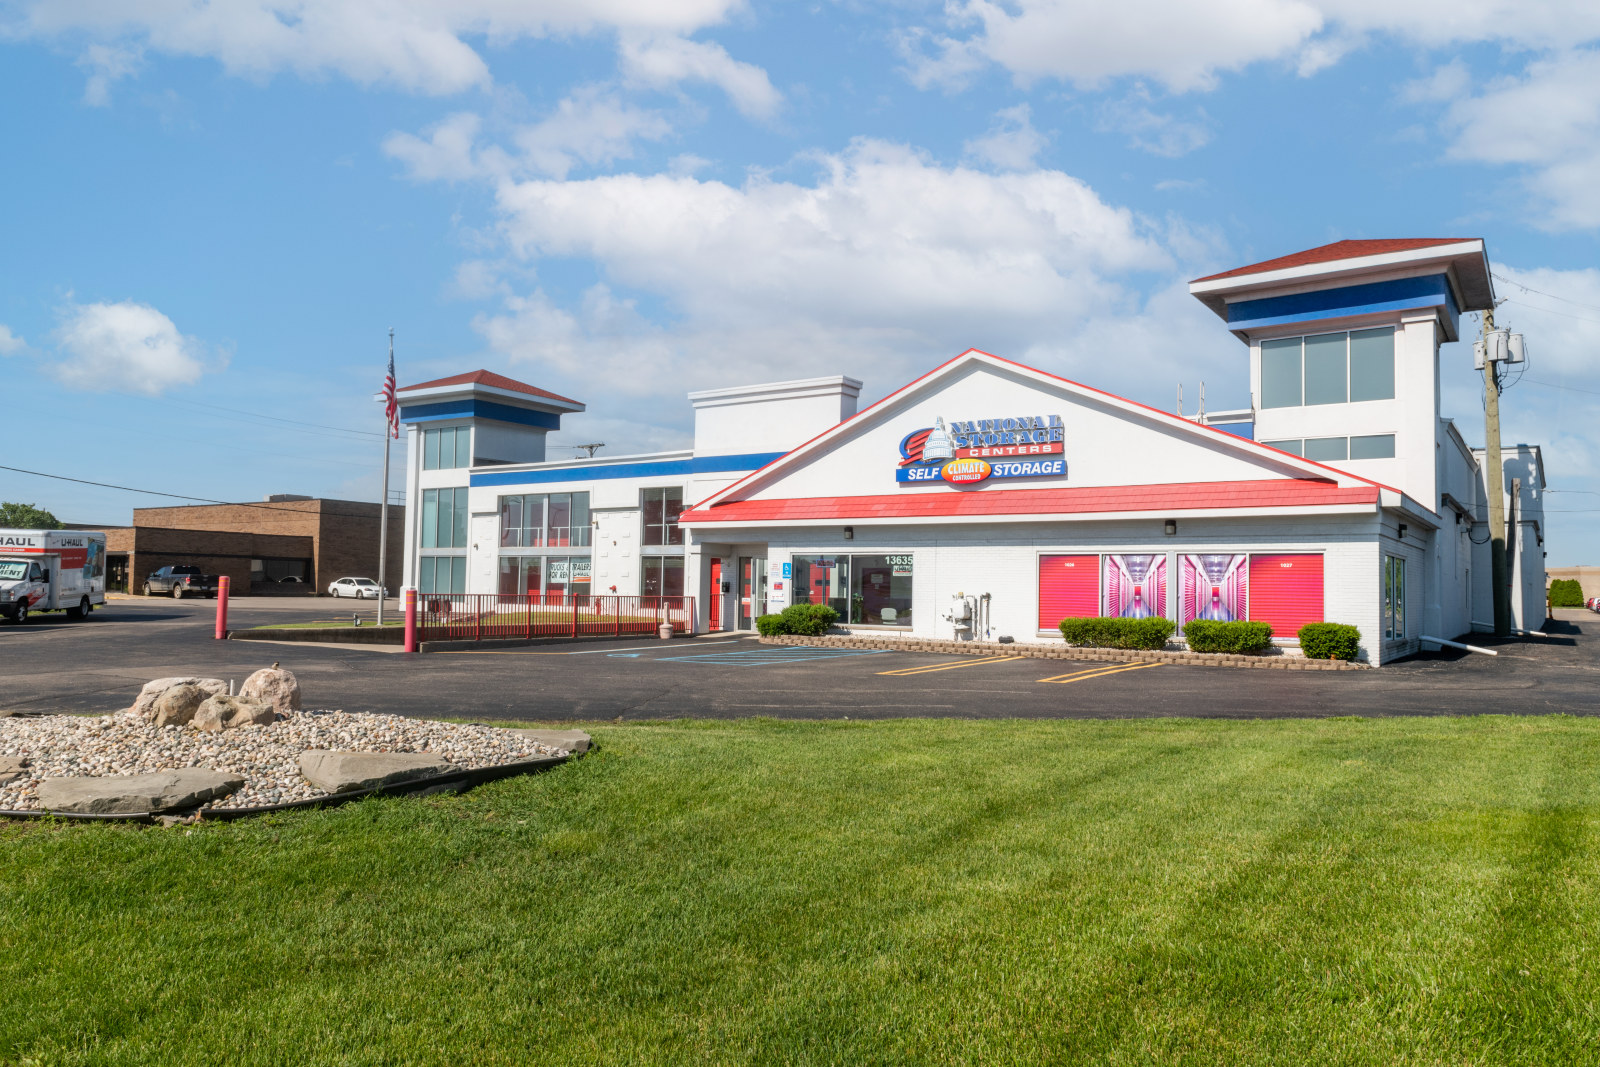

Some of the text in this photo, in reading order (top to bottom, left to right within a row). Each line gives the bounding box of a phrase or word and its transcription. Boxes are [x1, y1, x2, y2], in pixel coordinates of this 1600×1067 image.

[951, 414, 1063, 434] NATIONAL
[956, 428, 1063, 448] STORAGE
[969, 445, 1052, 457] CENTERS
[907, 461, 1063, 480] SELF STORAGE
[947, 461, 985, 475] CLIMATE
[952, 473, 981, 482] CONTROLLED
[885, 556, 913, 565] 13635
